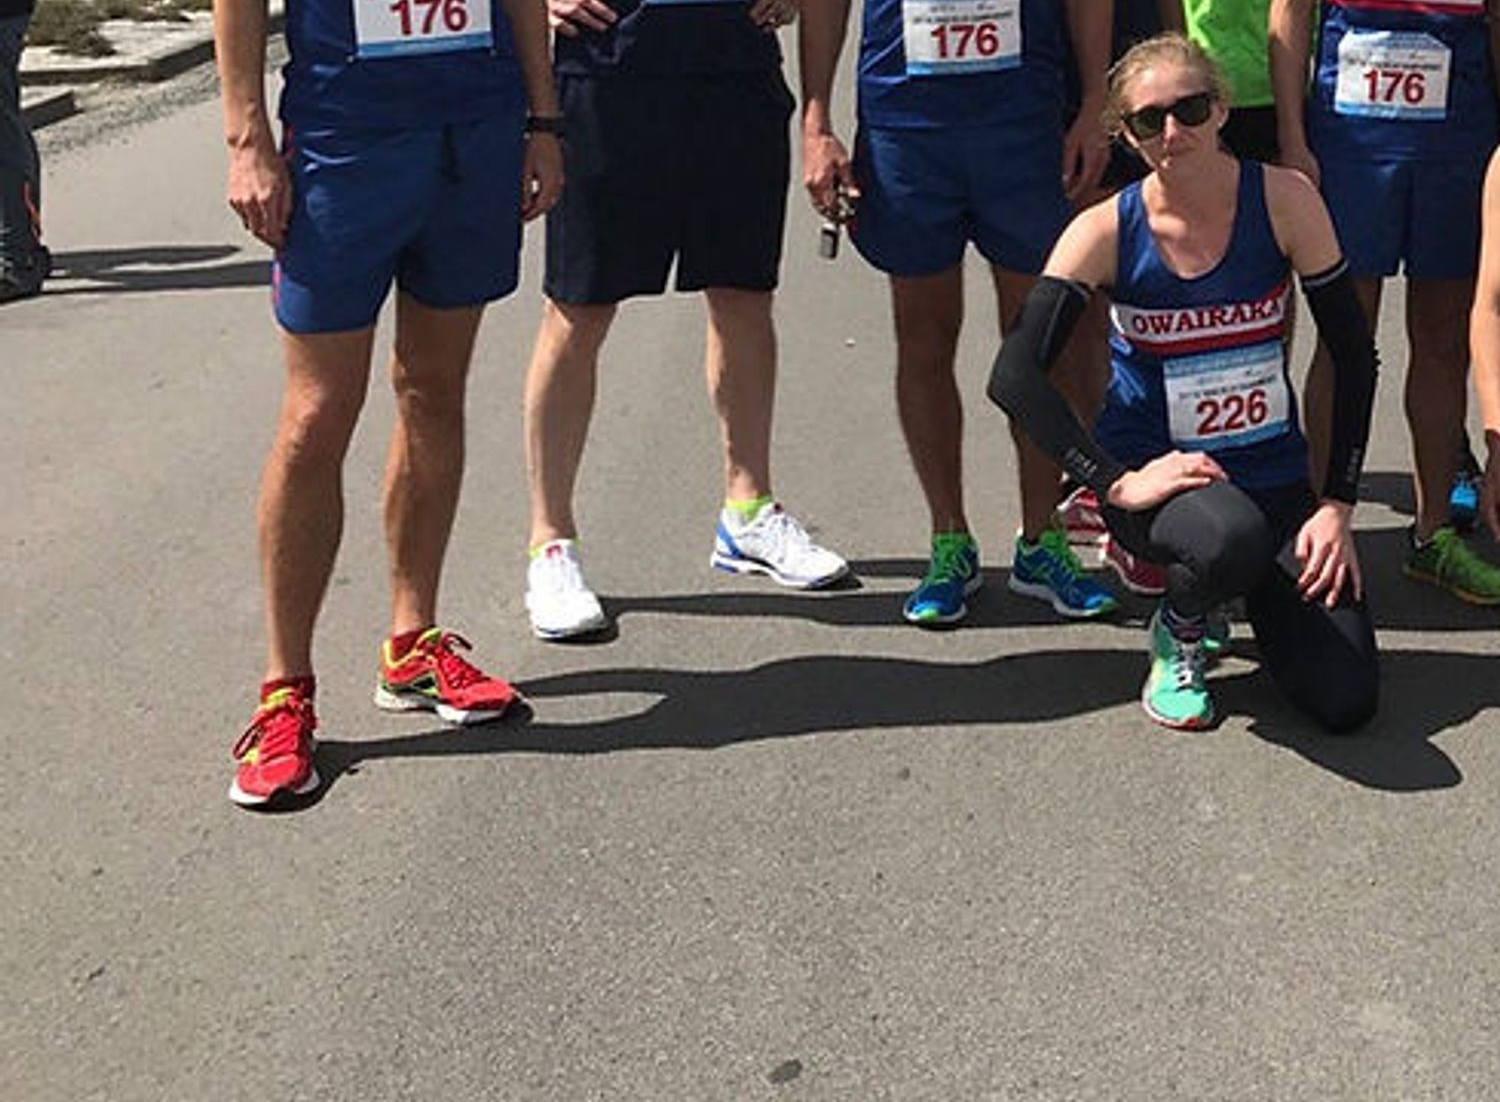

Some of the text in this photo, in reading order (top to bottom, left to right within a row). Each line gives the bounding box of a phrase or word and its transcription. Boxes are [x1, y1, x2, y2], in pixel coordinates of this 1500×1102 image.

[931, 22, 999, 58] 176
[1364, 69, 1425, 105] 176
[1196, 389, 1267, 436] 226
